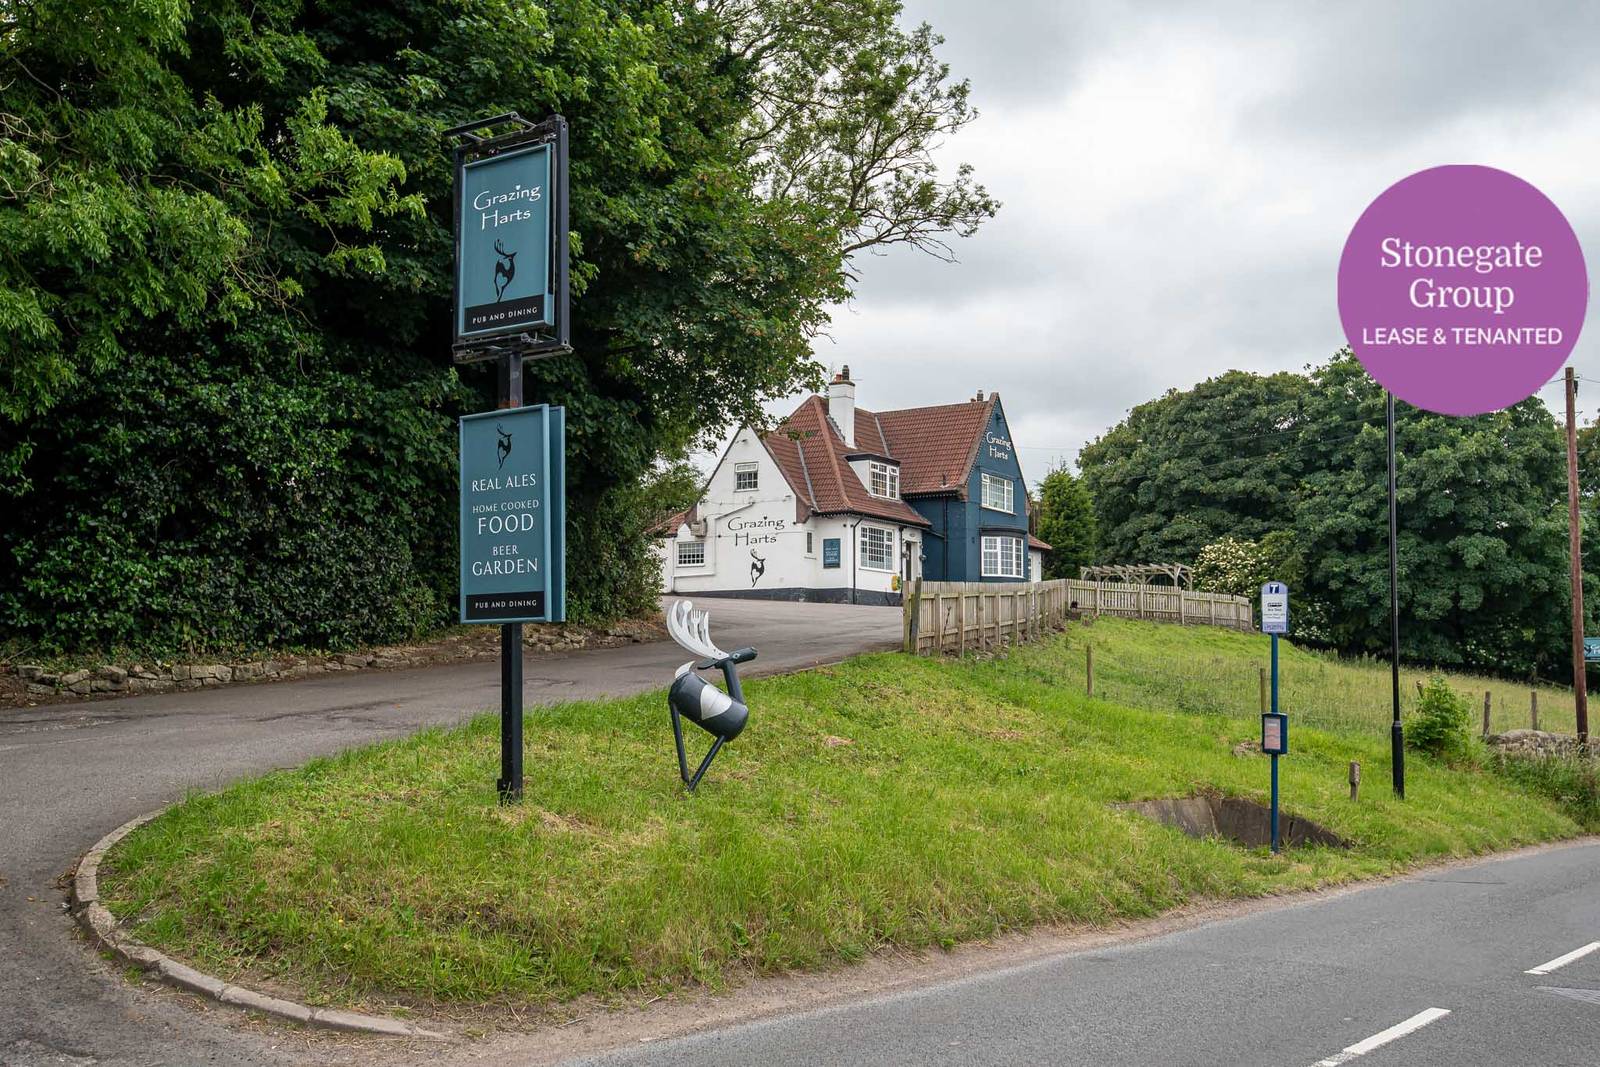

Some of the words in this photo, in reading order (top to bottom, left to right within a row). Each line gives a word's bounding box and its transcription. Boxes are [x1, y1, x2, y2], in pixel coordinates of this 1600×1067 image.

[473, 185, 541, 211] Grazing
[481, 208, 531, 230] Harts
[472, 315, 487, 324] PUB
[489, 312, 505, 321] AND
[508, 306, 538, 318] DINING
[986, 431, 1011, 450] Grazing
[989, 445, 1008, 460] Harts
[472, 477, 501, 492] REAL
[505, 473, 536, 488] ALES
[472, 503, 498, 514] HOME
[501, 500, 539, 511] COOKED
[478, 513, 534, 535] FOOD
[728, 516, 785, 531] Grazing
[735, 531, 777, 546] Harts
[492, 545, 519, 556] BEER
[472, 558, 538, 576] GARDEN
[491, 600, 506, 608] AND
[508, 599, 537, 608] DINING
